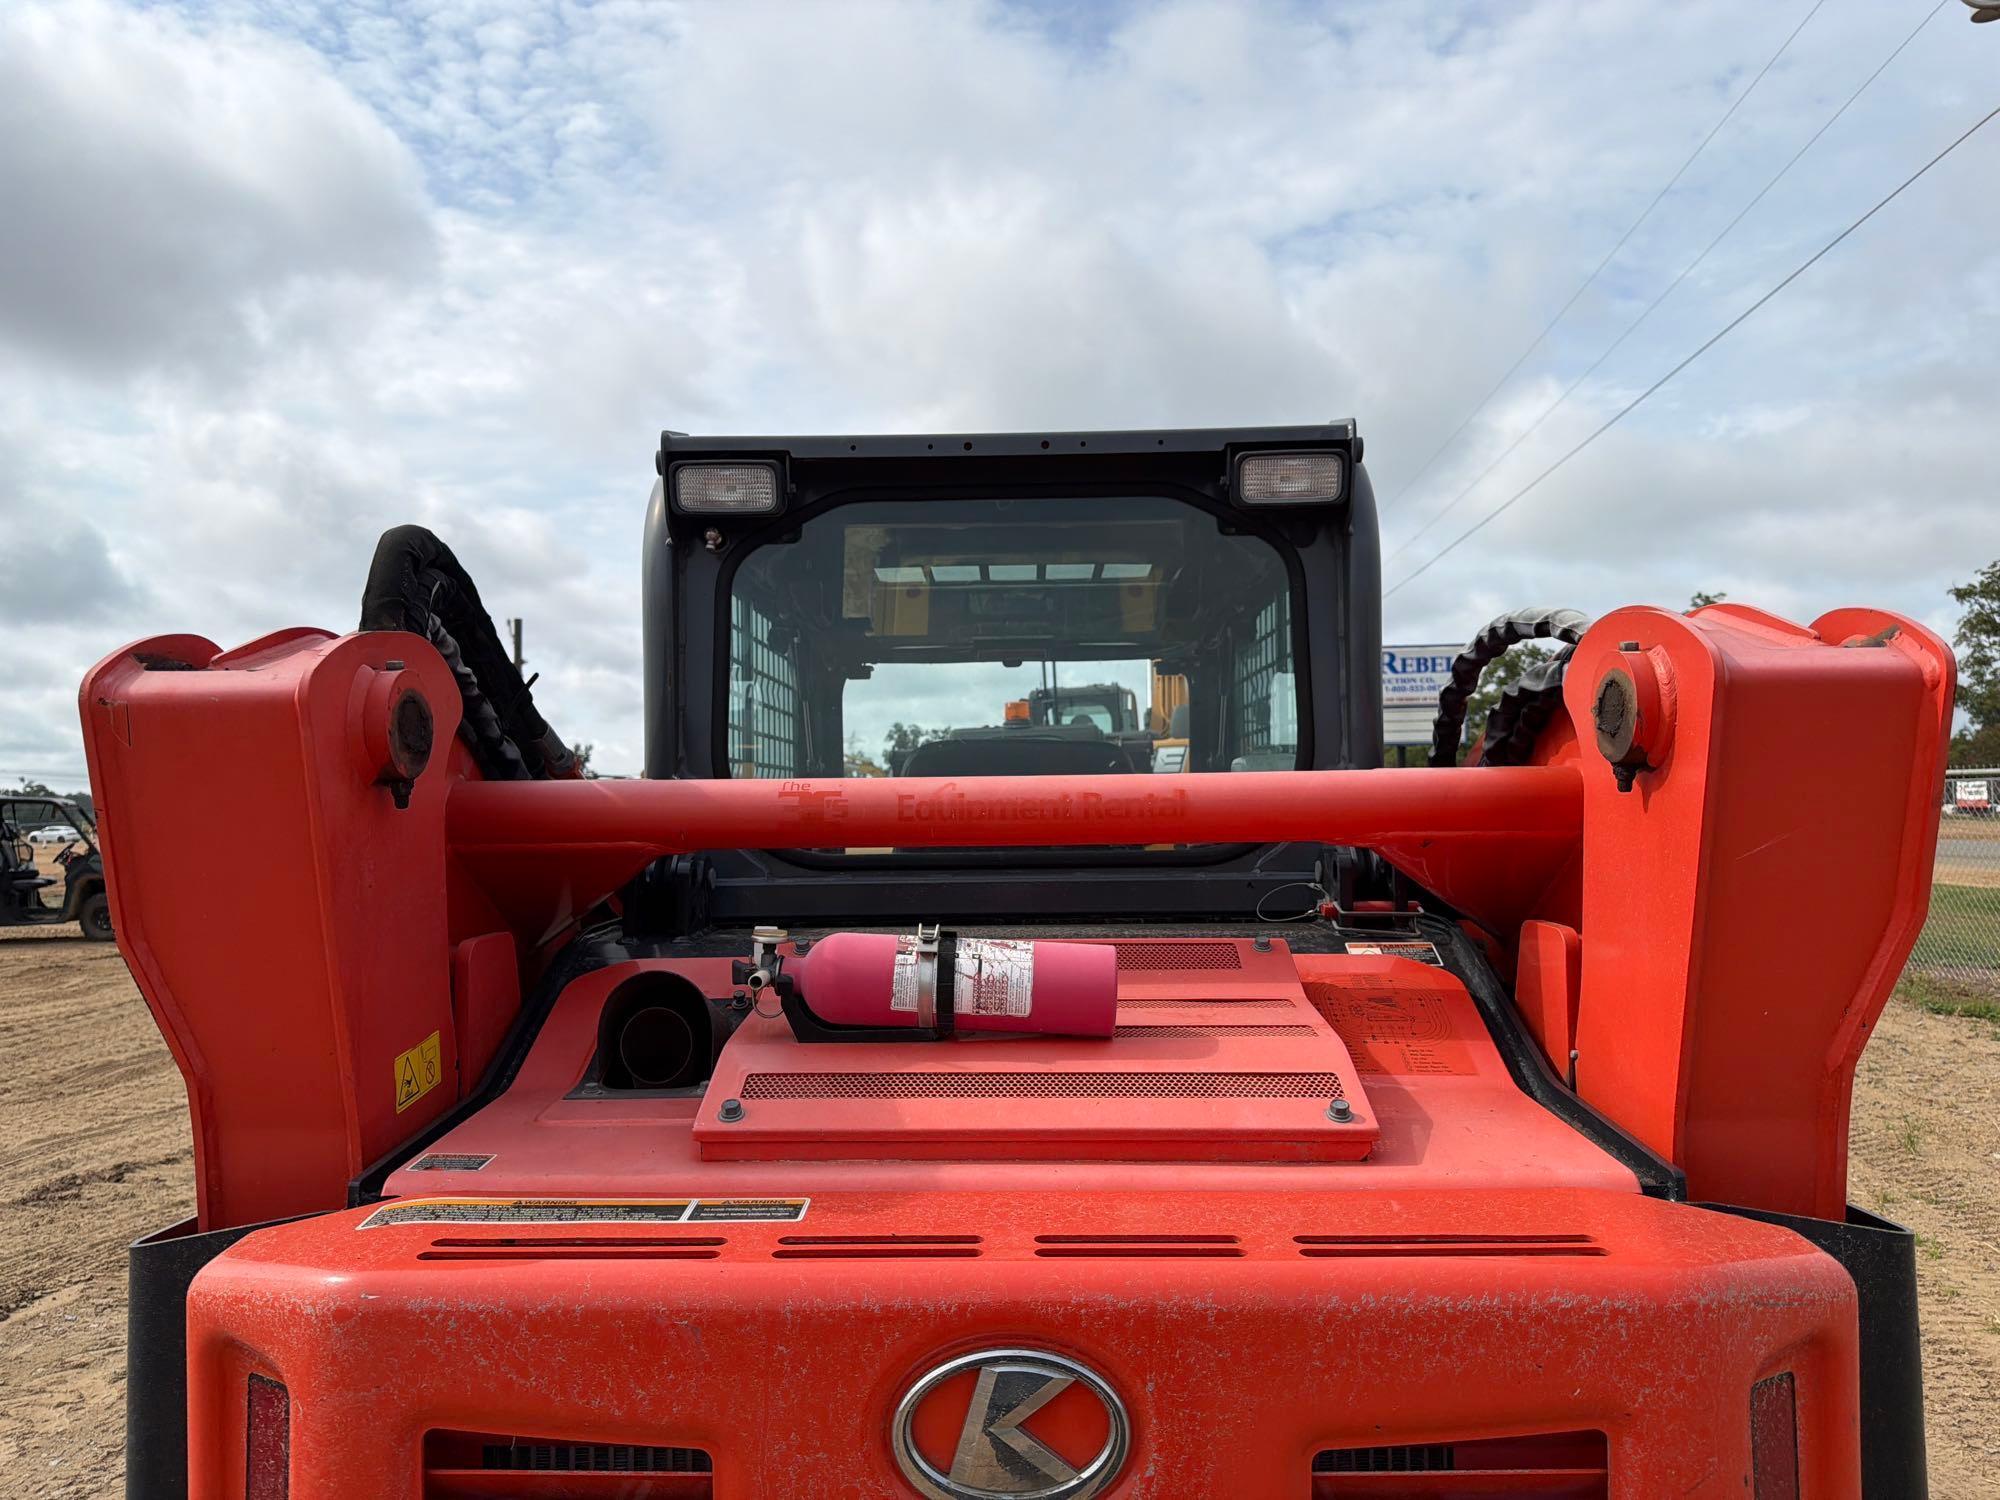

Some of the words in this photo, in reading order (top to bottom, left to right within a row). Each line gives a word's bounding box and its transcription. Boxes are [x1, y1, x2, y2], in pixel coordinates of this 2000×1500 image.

[1382, 651, 1453, 674] REBEL
[782, 781, 811, 791] The
[897, 792, 1070, 826] Equipment
[1081, 788, 1187, 820] Rental
